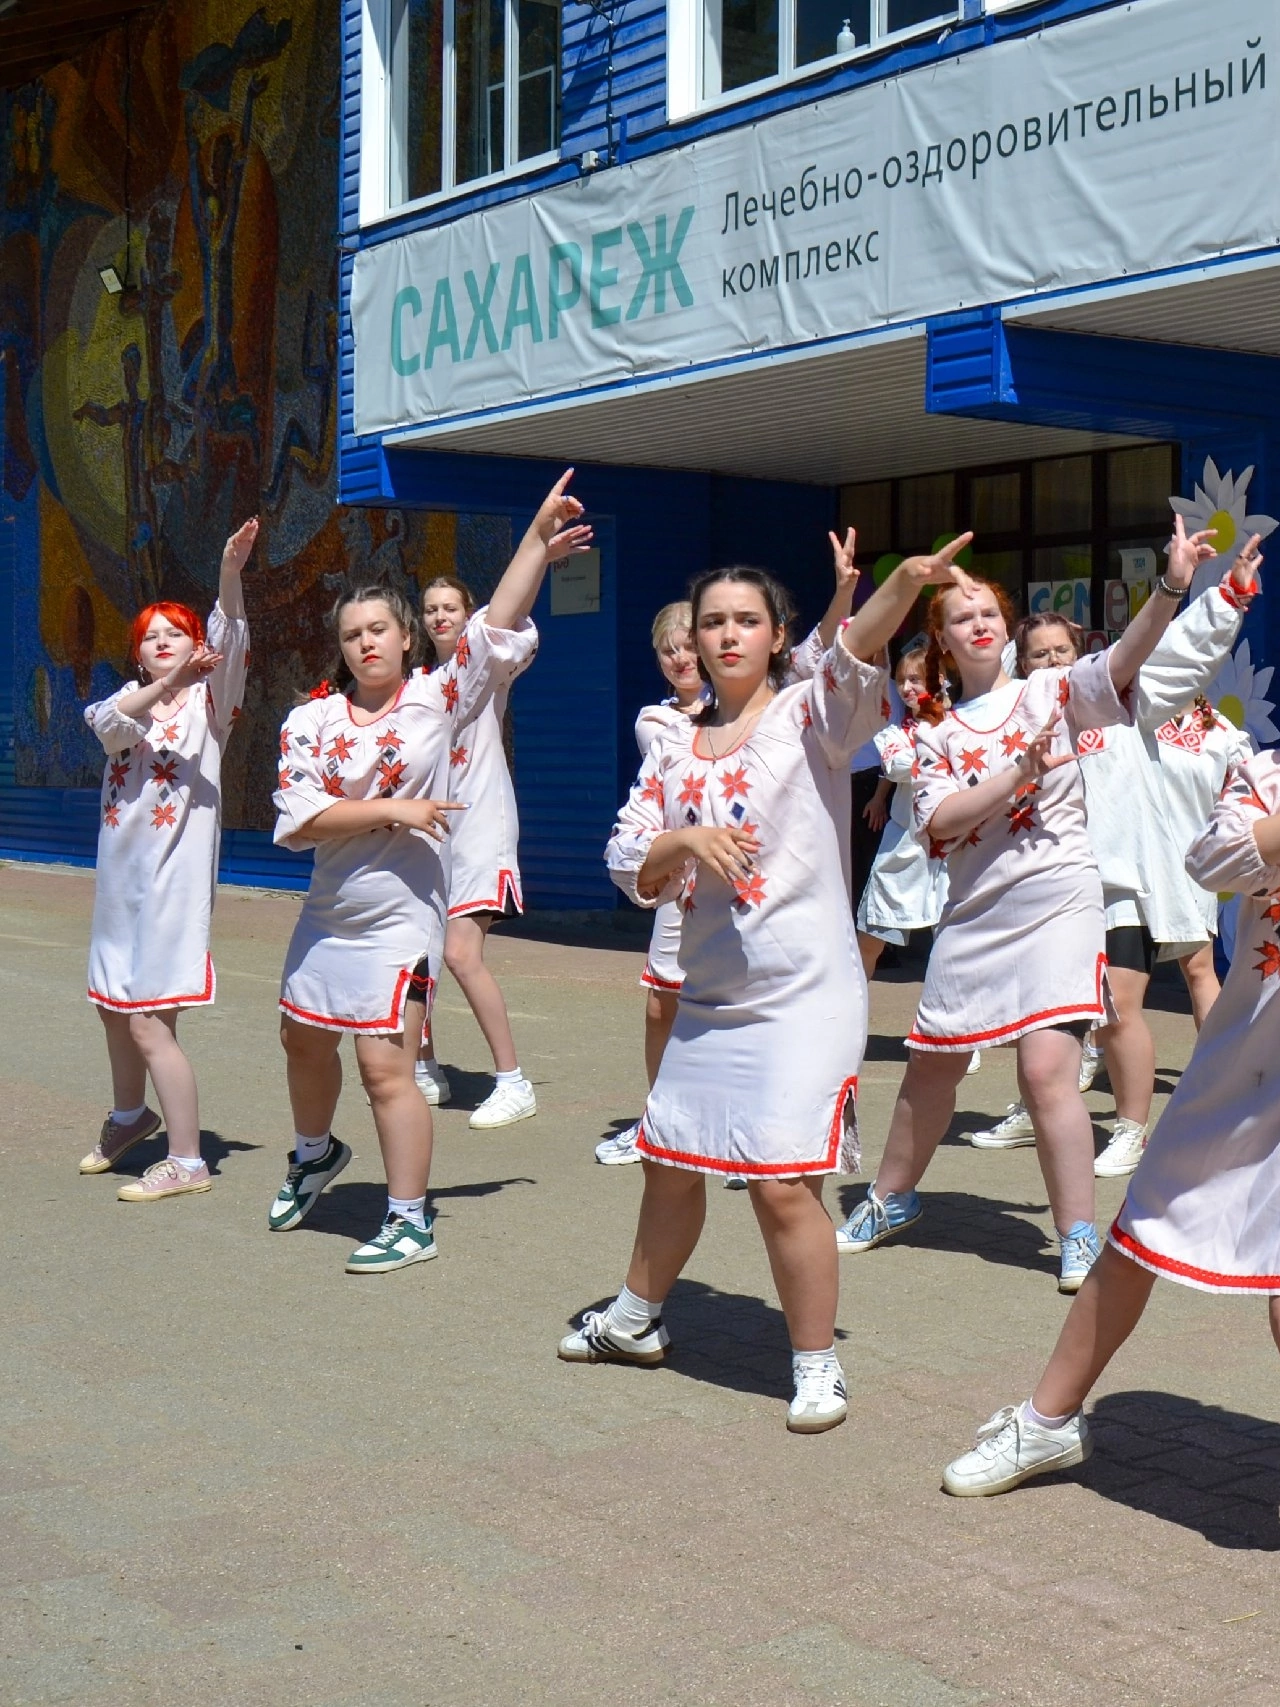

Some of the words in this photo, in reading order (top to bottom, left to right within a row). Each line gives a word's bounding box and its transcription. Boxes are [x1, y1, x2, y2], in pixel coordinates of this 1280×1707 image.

[720, 36, 1268, 235] Лечебно-оздоровительный
[389, 206, 695, 378] САХАРЕЖ
[720, 229, 881, 298] комплекс
